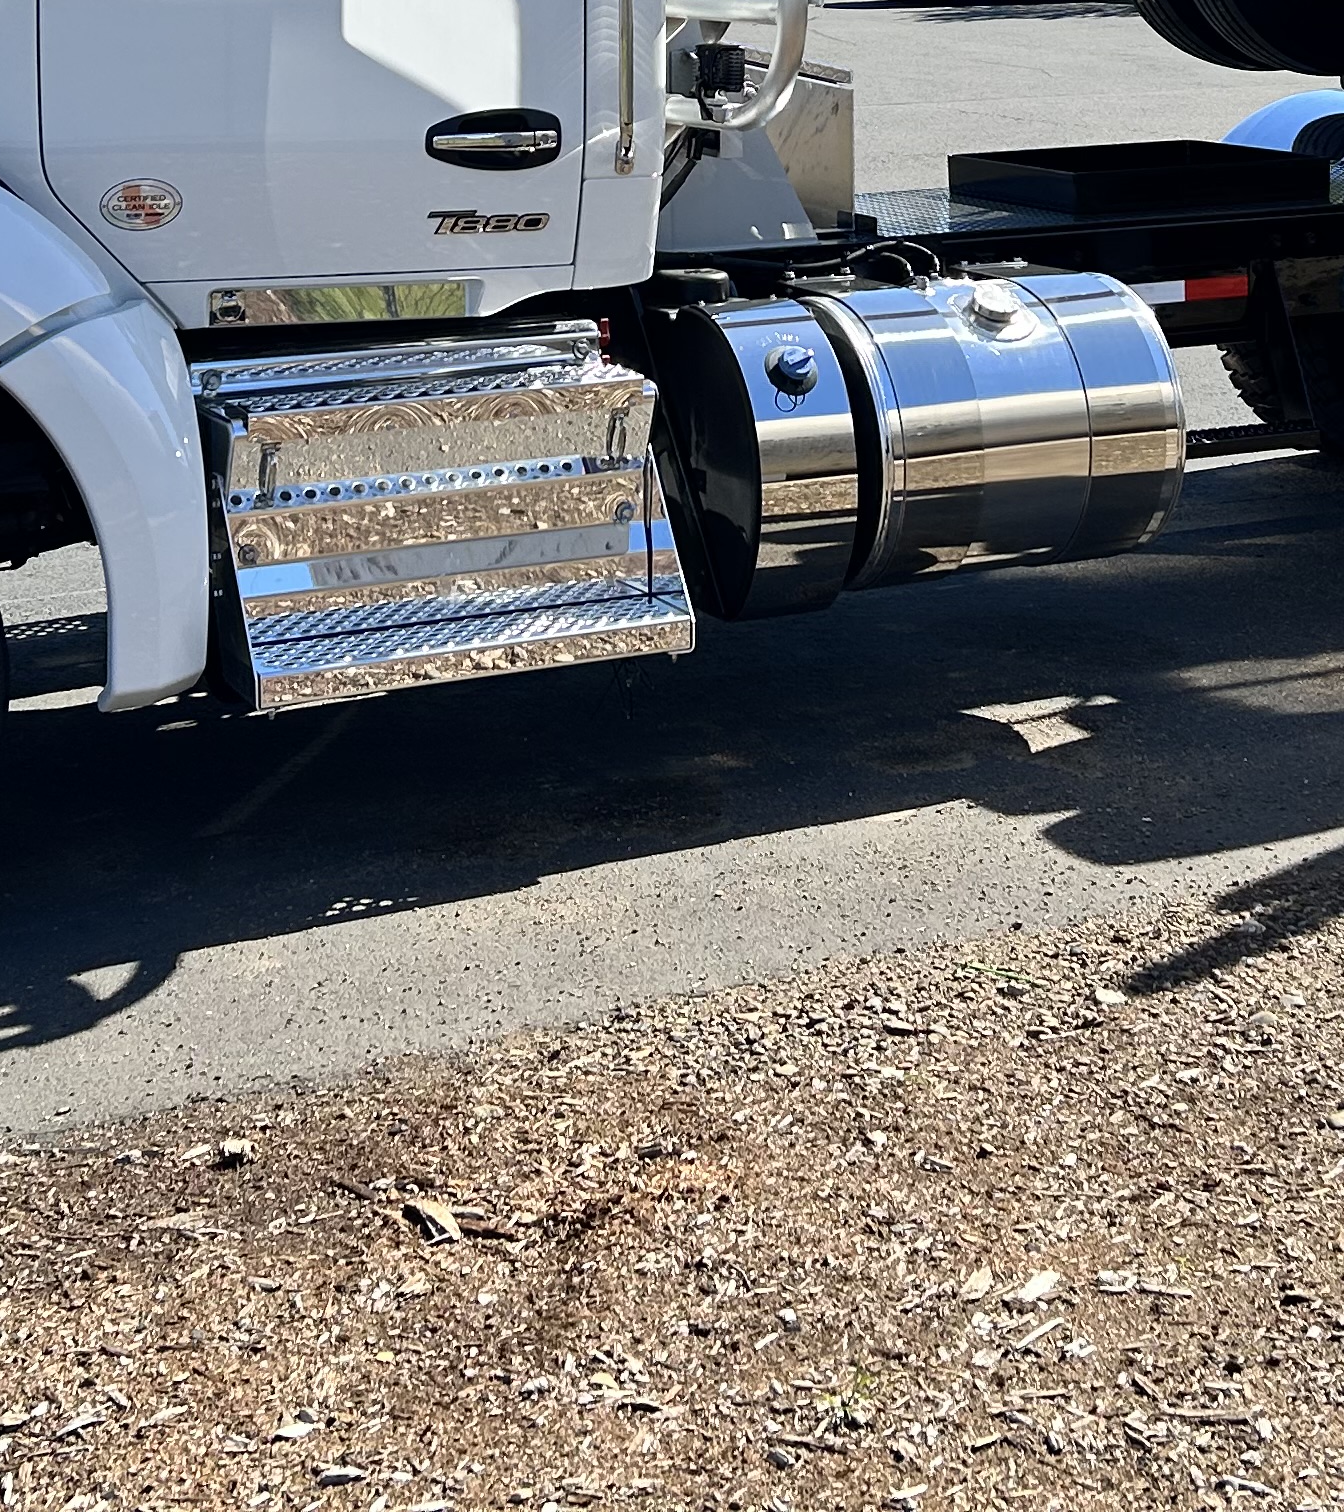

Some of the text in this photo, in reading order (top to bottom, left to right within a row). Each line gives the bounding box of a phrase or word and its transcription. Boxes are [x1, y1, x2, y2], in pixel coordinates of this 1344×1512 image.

[116, 194, 167, 203] CERTIFIED
[111, 202, 171, 212] CLEAN IDLE
[426, 209, 551, 236] T880
